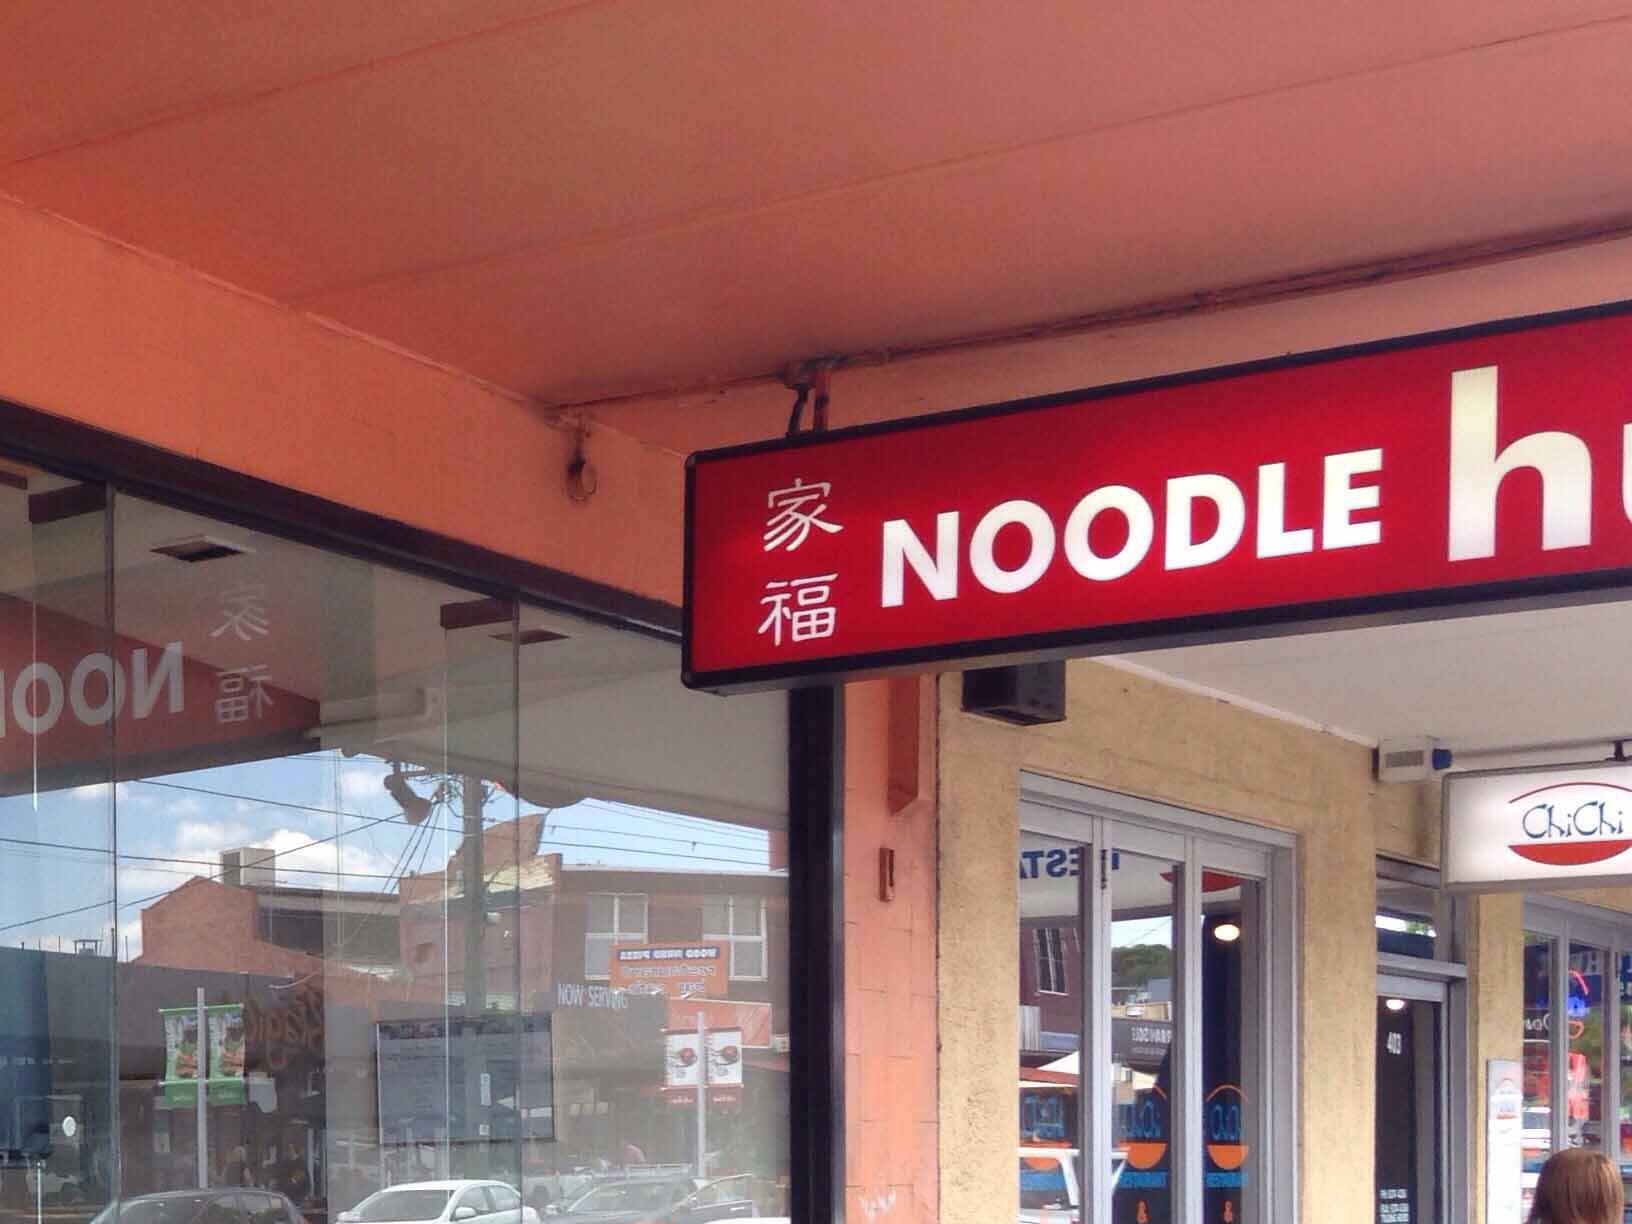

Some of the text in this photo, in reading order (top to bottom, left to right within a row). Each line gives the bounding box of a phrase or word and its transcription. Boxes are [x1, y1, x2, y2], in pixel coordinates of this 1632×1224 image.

[881, 366, 1632, 608] NOODLE h
[1522, 800, 1624, 838] ChiChi
